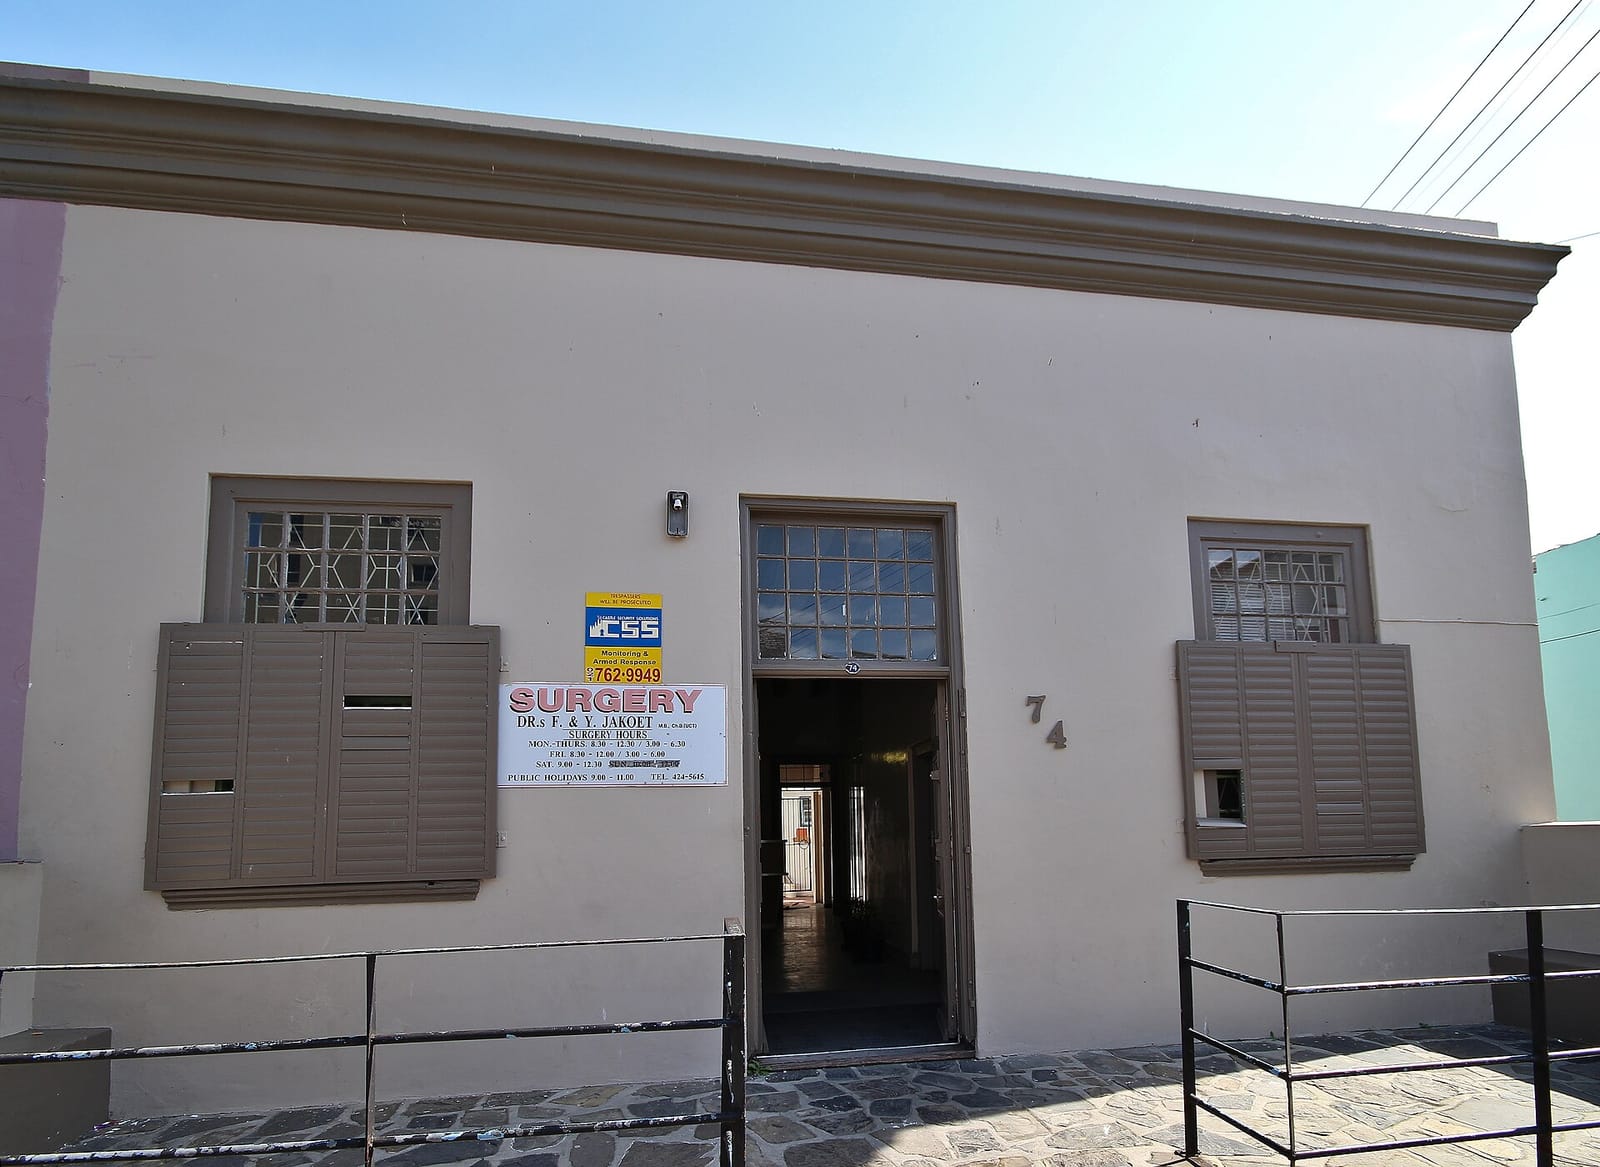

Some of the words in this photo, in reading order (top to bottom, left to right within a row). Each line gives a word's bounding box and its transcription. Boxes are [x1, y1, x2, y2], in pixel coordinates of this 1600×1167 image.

[602, 620, 658, 638] CSS
[510, 688, 702, 713] SURGERY
[518, 716, 545, 728] DR.s
[552, 716, 562, 728] F.
[569, 716, 578, 728] &
[585, 716, 596, 728] Y.
[602, 716, 653, 728] JAKOET
[568, 730, 611, 738] SURGERY
[616, 730, 648, 738] HOURS
